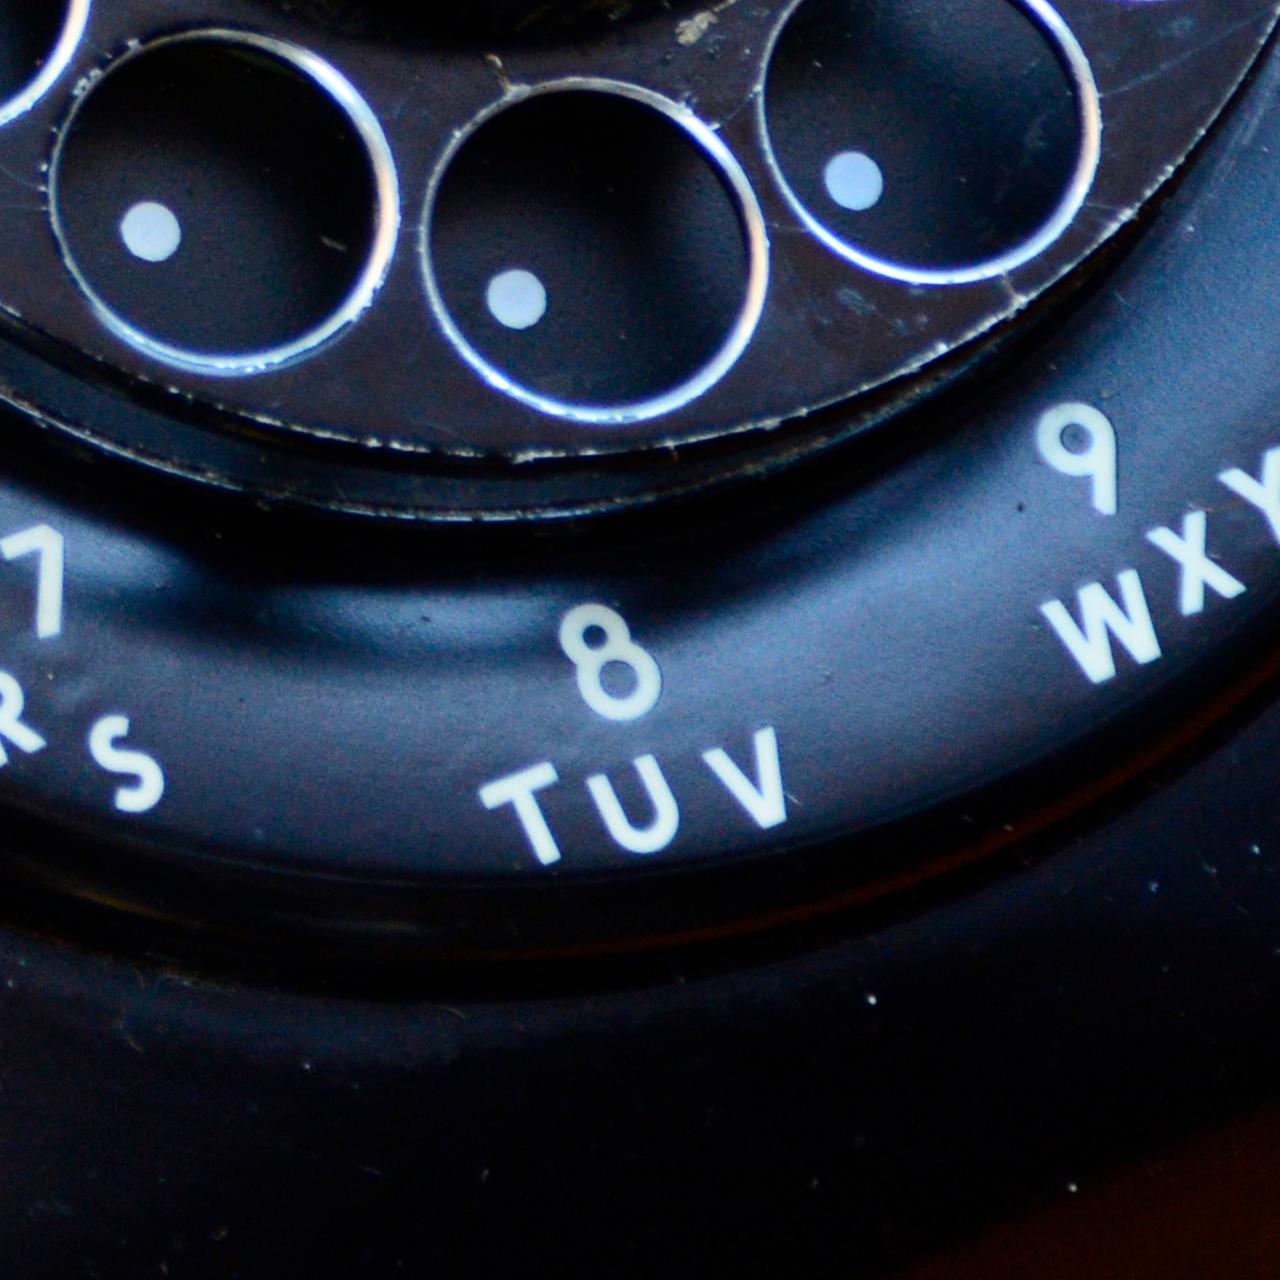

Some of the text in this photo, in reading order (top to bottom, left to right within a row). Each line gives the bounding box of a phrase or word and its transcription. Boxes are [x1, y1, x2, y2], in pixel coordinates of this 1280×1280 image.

[1036, 401, 1119, 517] 9
[559, 604, 662, 723] 8
[478, 725, 787, 865] TUV
